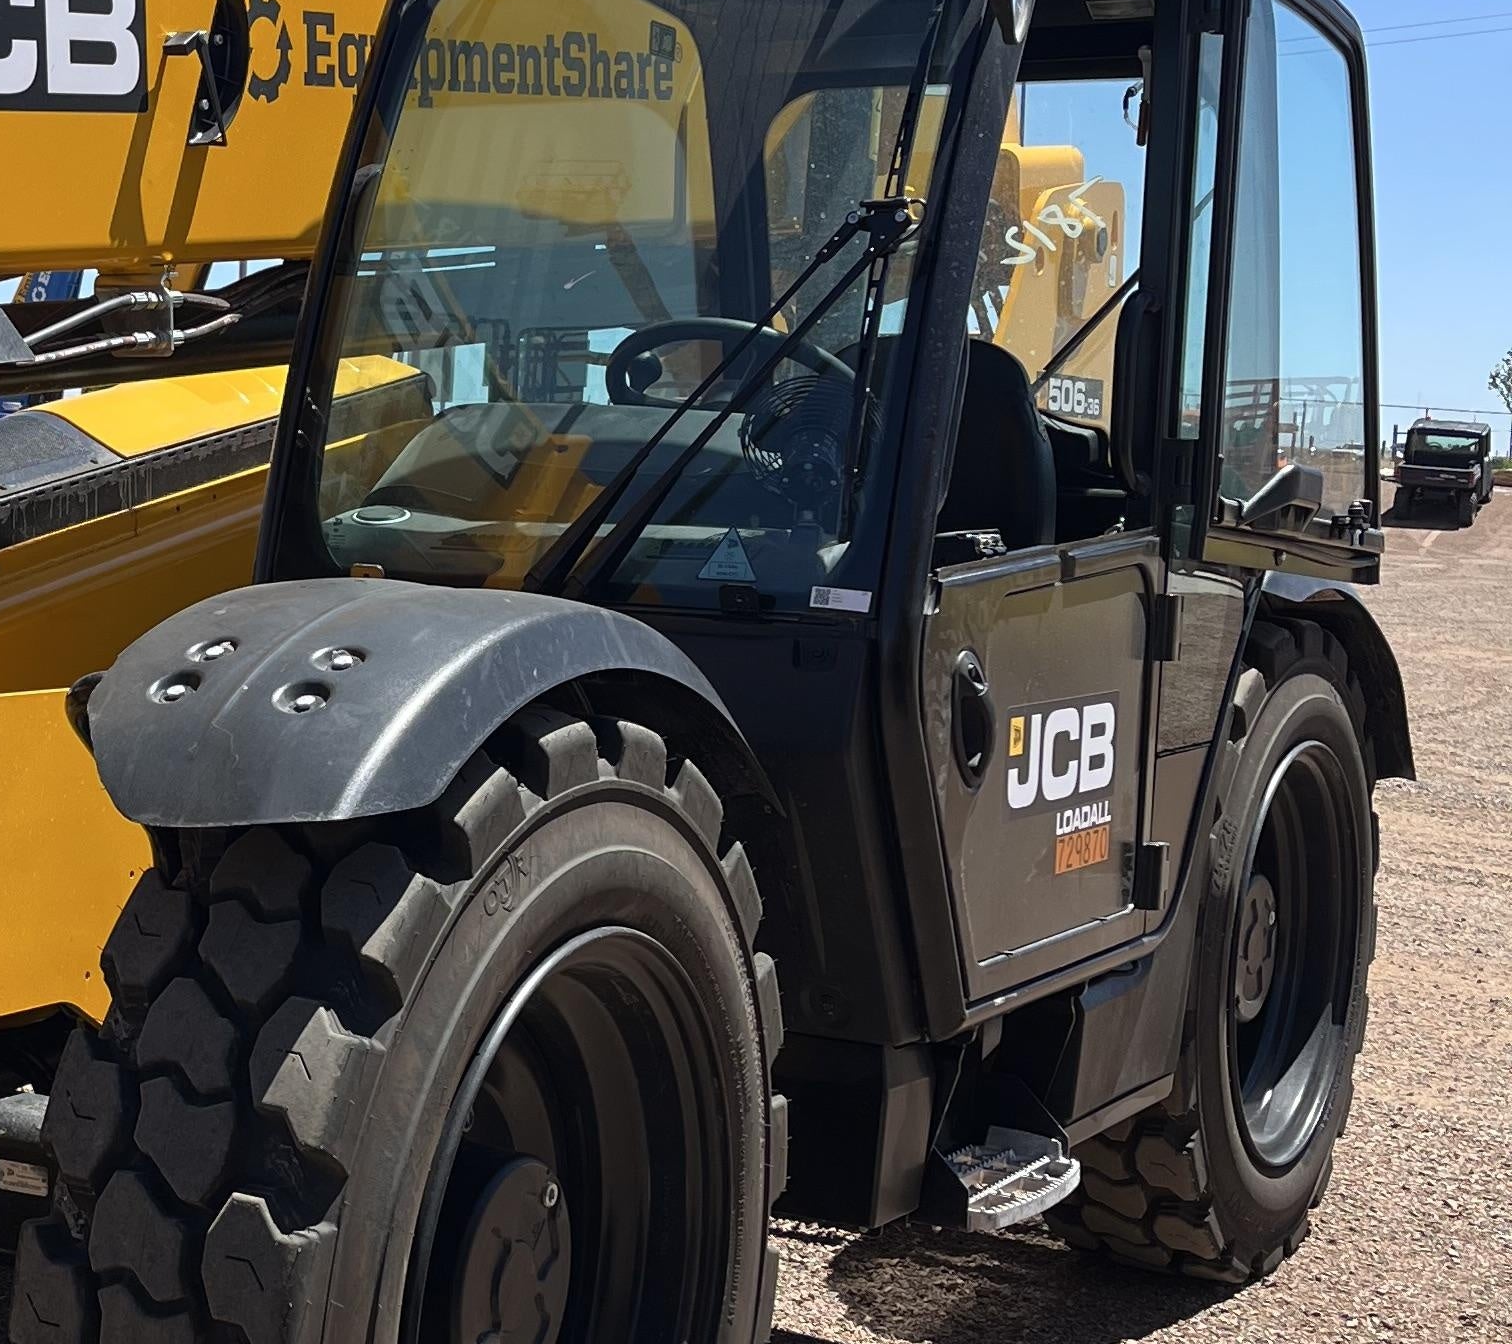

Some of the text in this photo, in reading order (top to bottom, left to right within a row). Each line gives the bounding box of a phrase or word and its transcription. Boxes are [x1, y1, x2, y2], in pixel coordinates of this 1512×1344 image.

[303, 10, 674, 108] EqpmentShare
[1007, 703, 1116, 809] JCB
[1055, 800, 1112, 836] LOADALL
[1057, 829, 1108, 873] 729870
